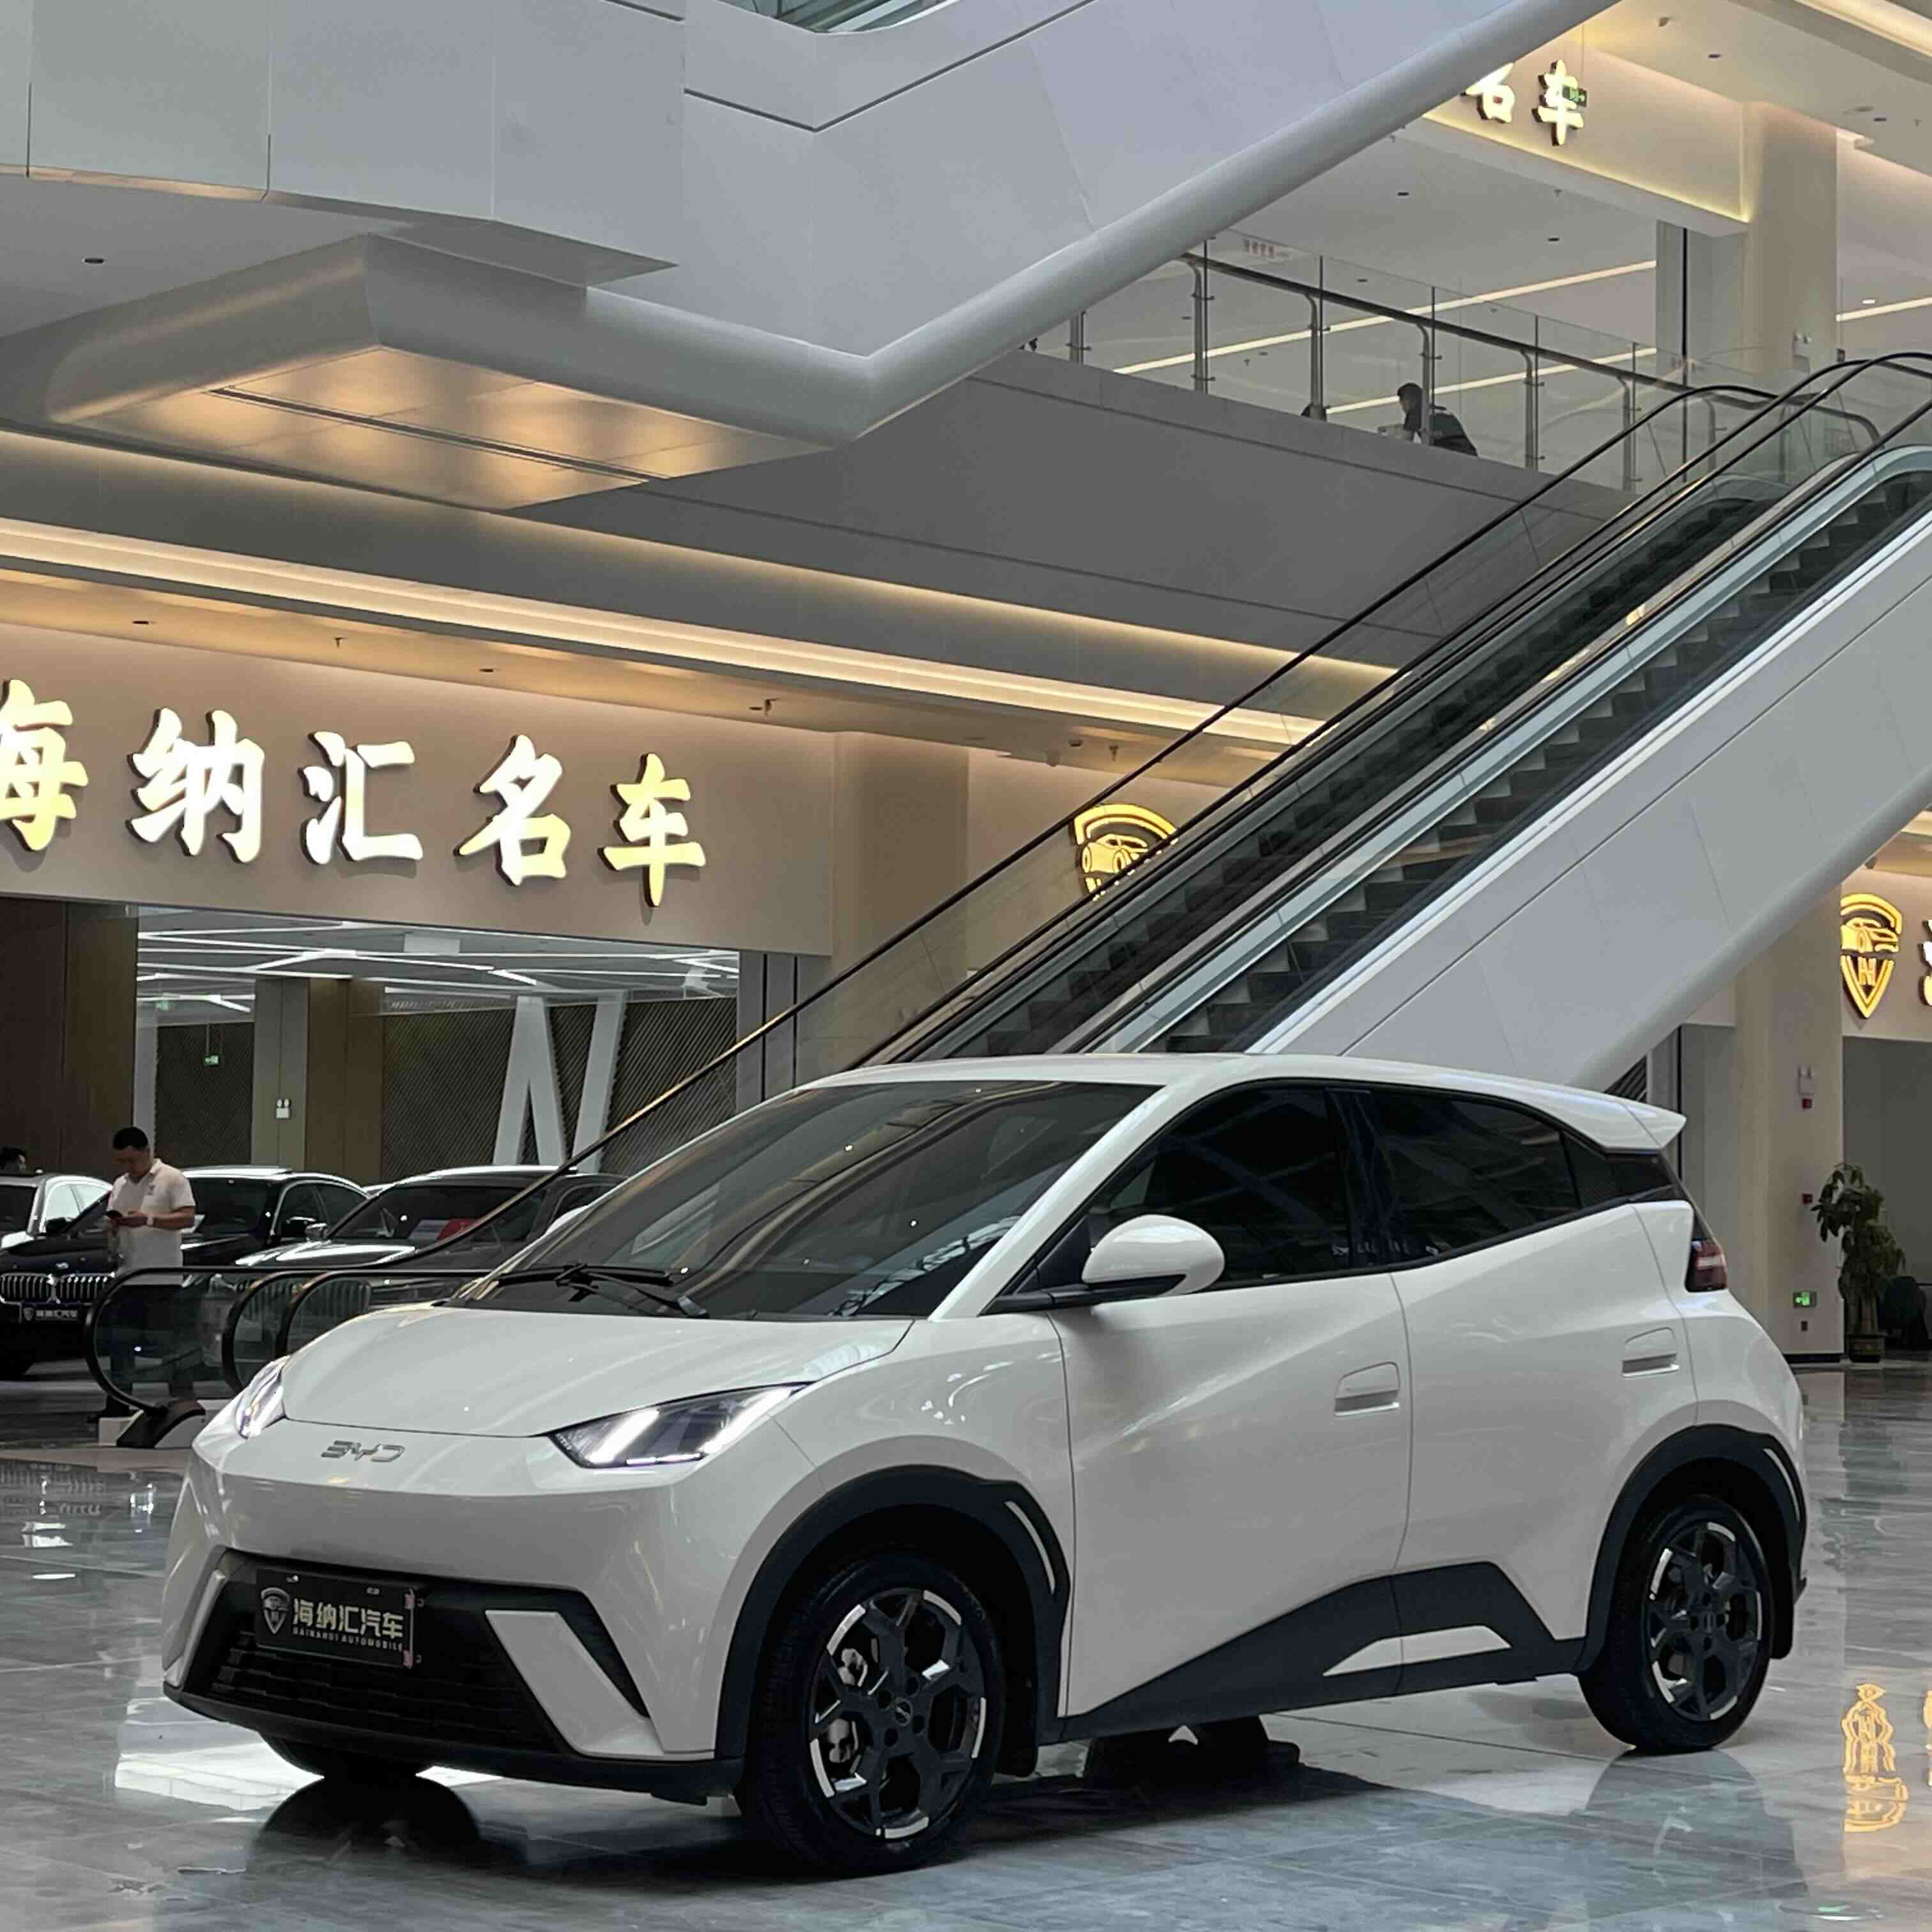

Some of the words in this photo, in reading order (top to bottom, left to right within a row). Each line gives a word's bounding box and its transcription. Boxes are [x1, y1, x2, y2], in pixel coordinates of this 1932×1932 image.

[321, 1440, 405, 1462] BYD
[292, 1598, 404, 1639] 海纳汇汽车
[341, 1633, 403, 1652] AUTOMOBILE
